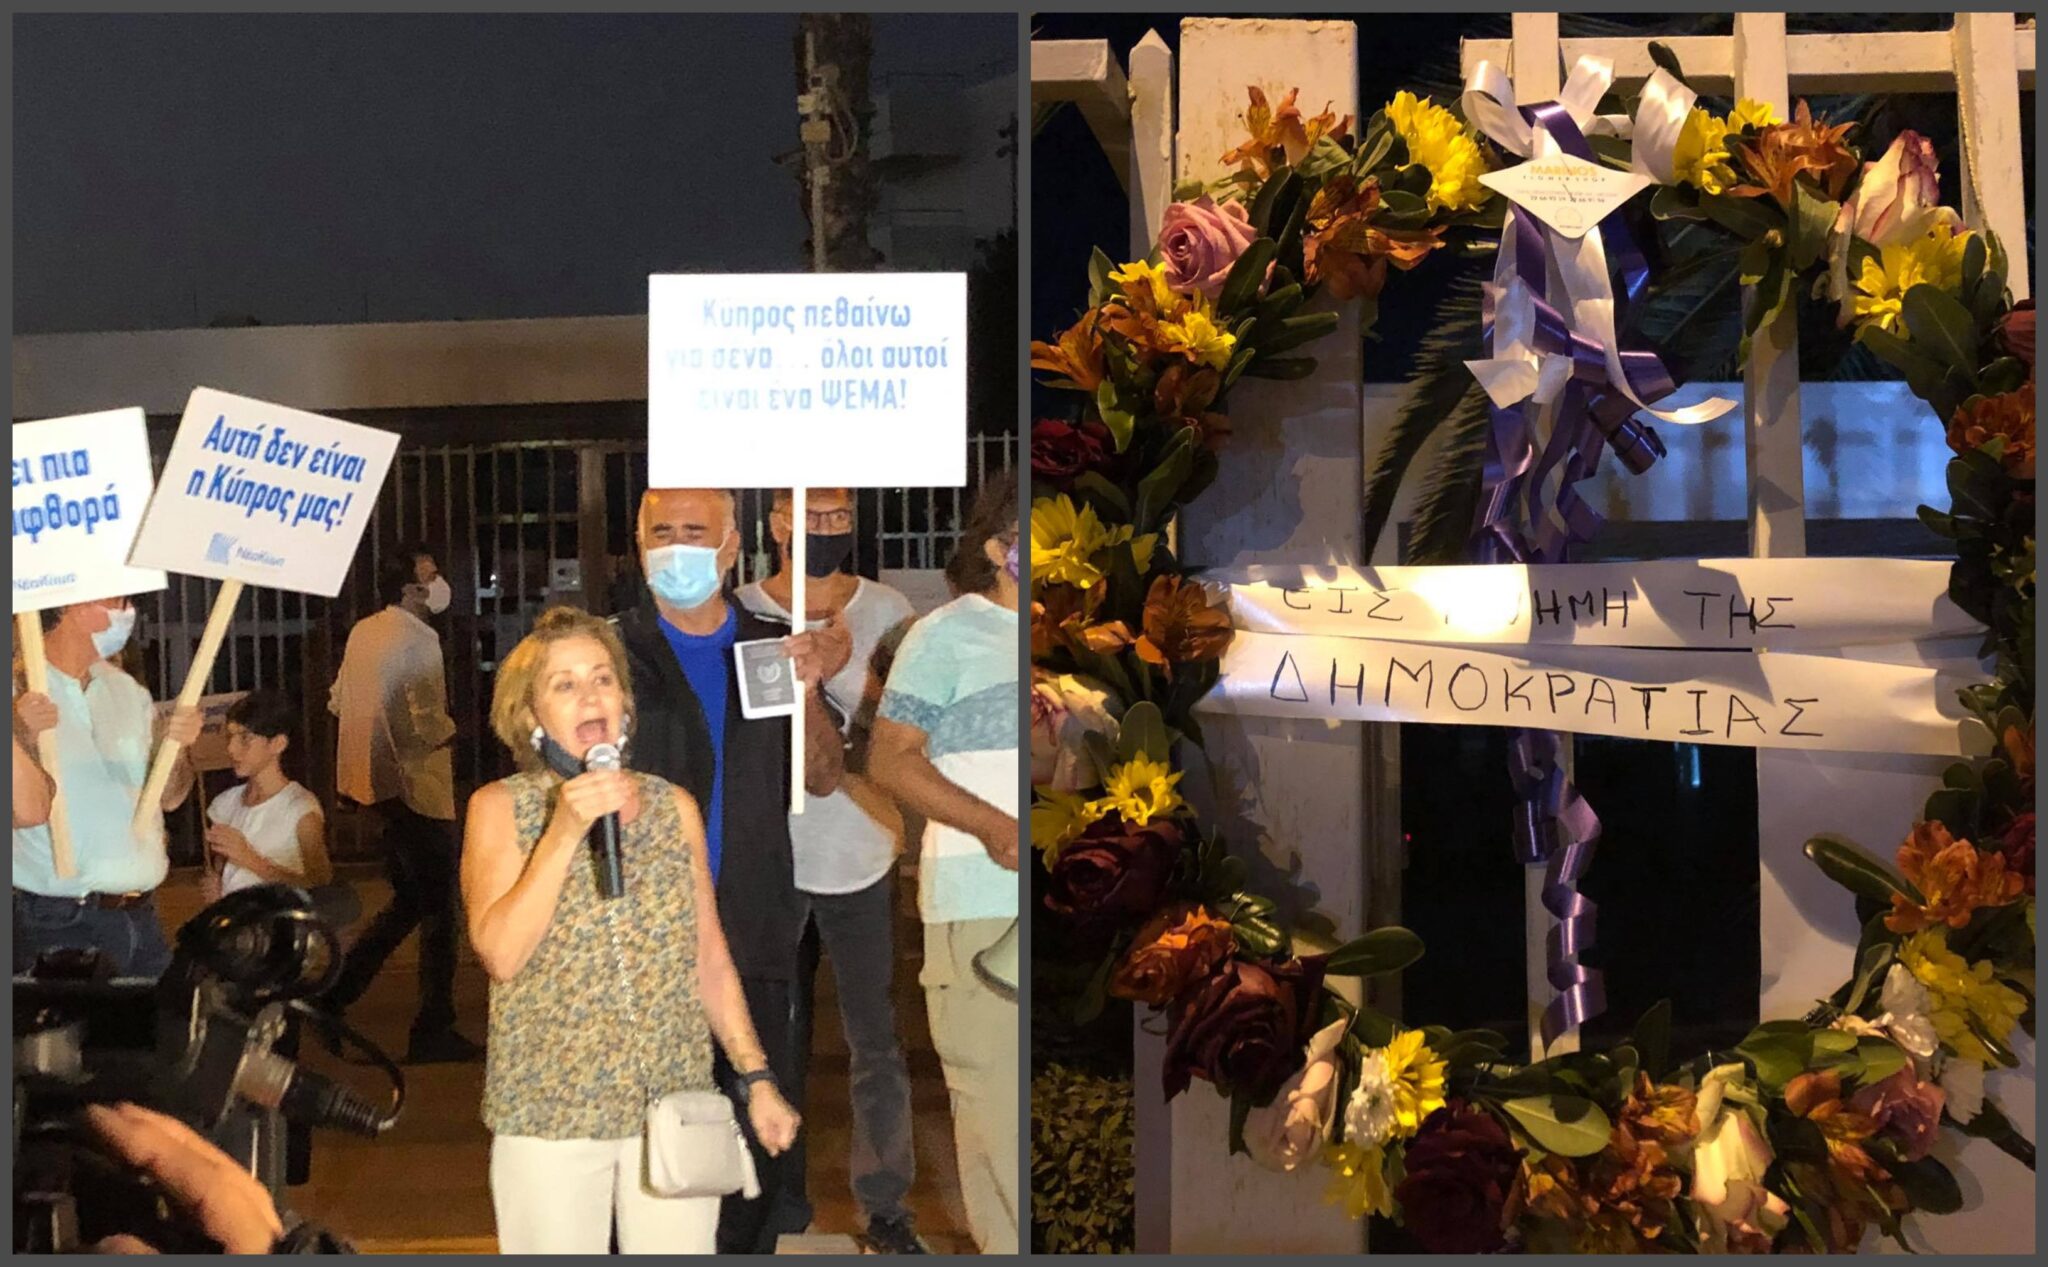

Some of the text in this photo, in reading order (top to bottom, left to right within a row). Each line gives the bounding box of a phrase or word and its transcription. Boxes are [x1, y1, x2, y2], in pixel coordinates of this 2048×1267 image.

[804, 295, 911, 328] πεθαίνω
[882, 336, 948, 369] αυτοί
[821, 378, 908, 410] ΨΕΜΑ!
[41, 448, 91, 482] πια
[202, 414, 367, 483] Αυτή δεν είναι
[186, 463, 354, 533] η Κύπρος μας!
[1683, 589, 1796, 639] ΤΗΣ
[1270, 650, 1824, 738] ΔΗΜΟΚΡΑΤΙΑΣ
